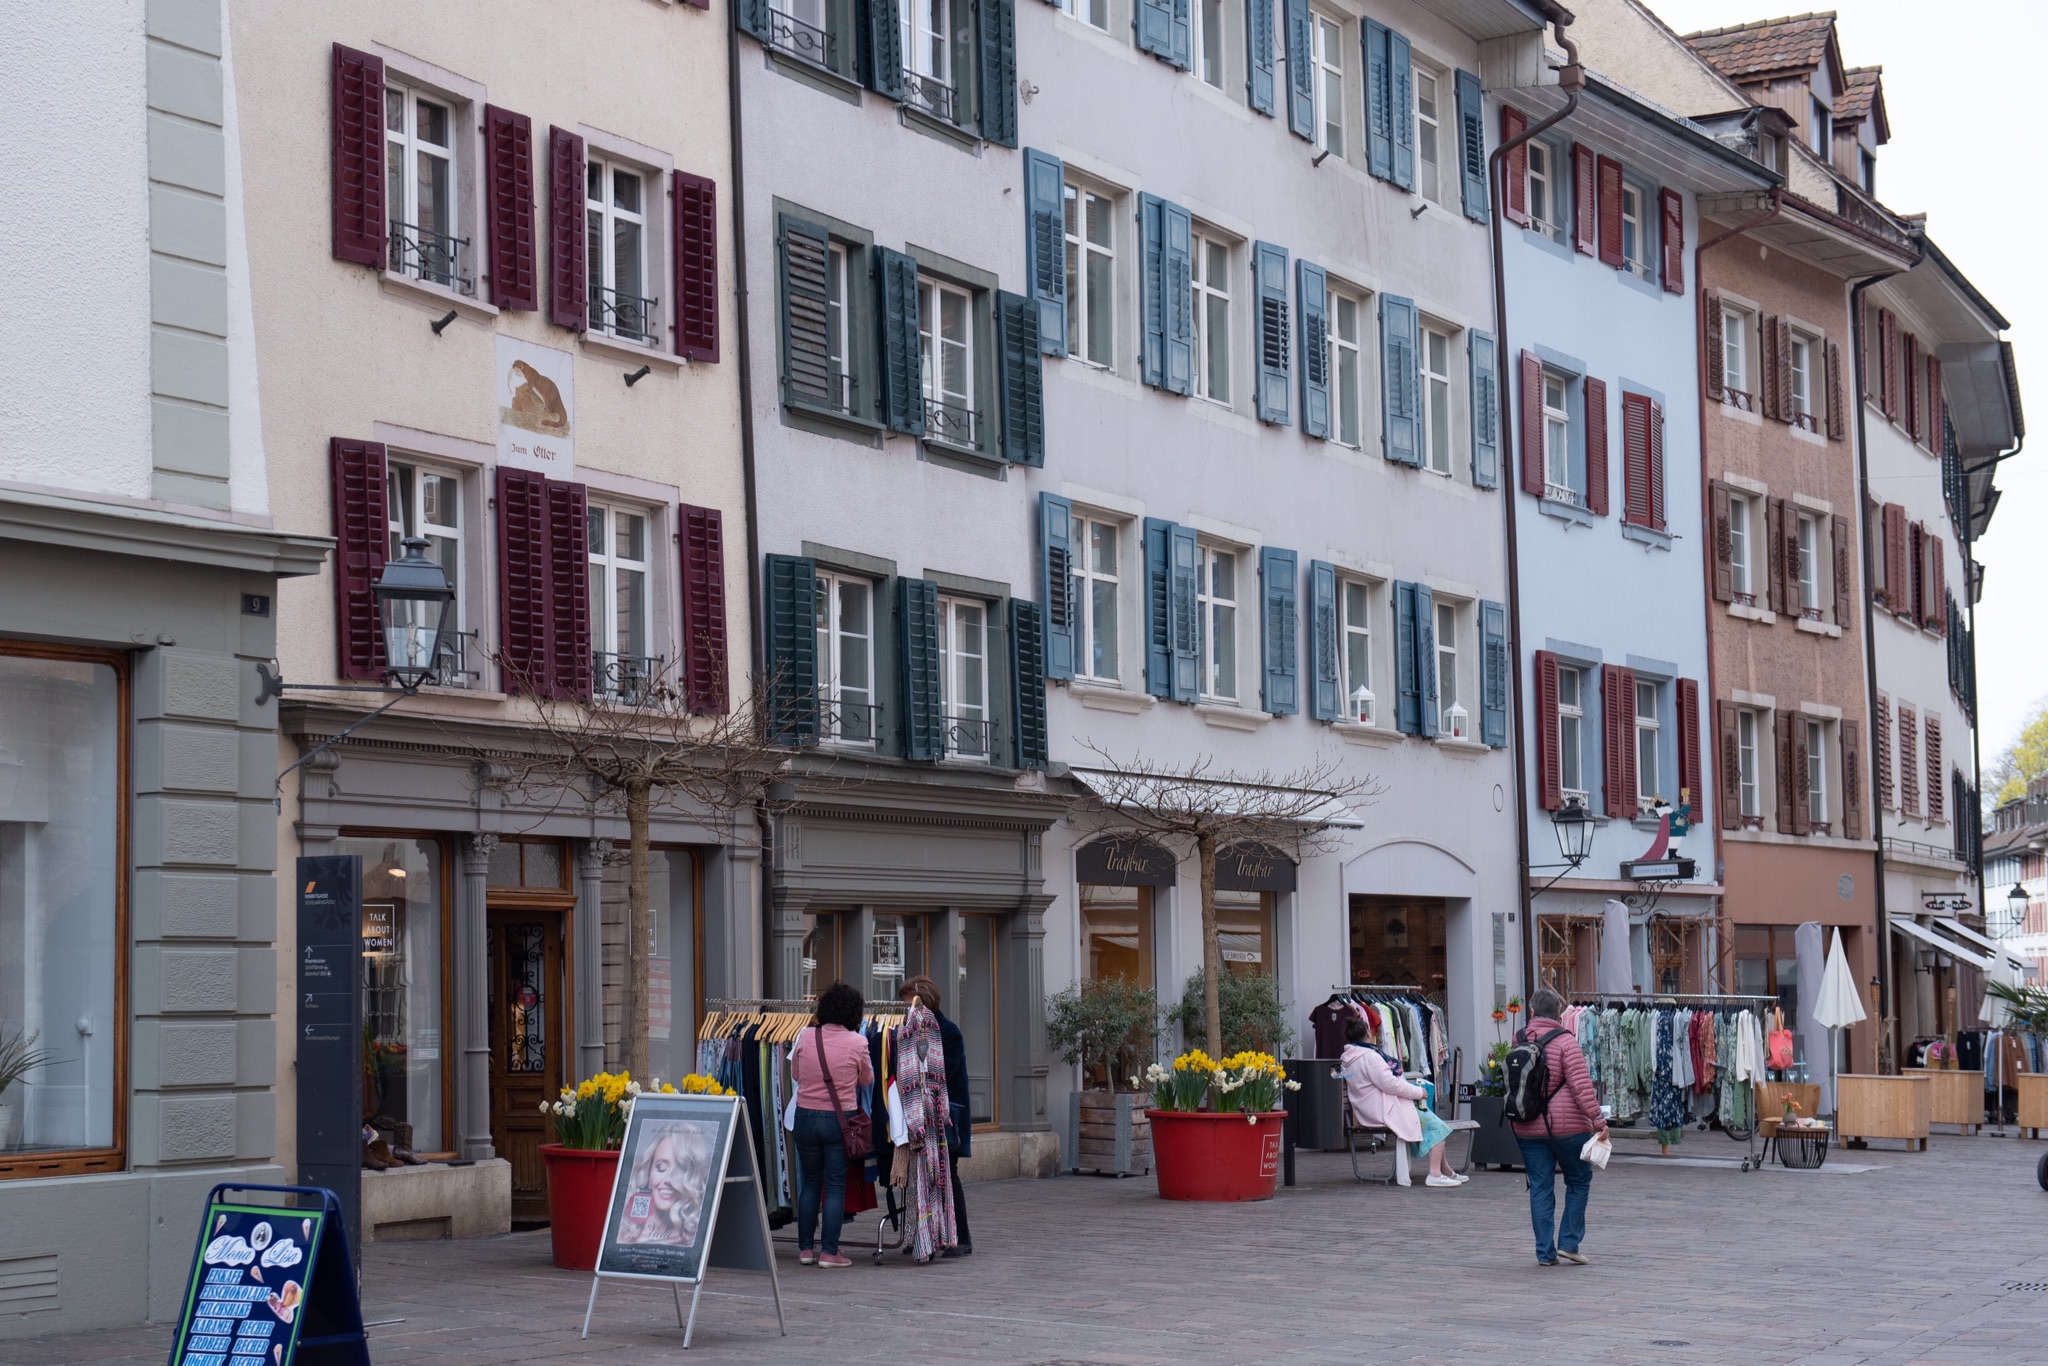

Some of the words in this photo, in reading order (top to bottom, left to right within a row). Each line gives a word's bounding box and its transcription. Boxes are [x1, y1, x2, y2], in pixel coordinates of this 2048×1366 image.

[533, 444, 557, 461] Otter
[252, 597, 260, 612] 9
[369, 913, 386, 922] TALK
[366, 925, 390, 934] ABOUT
[363, 938, 393, 947] WOMEN
[881, 946, 897, 954] ABOUT
[206, 1236, 253, 1261] Mona
[263, 1240, 299, 1265] Lisa
[196, 1302, 252, 1318] MILCHSHAKE
[191, 1318, 233, 1335] KARAMEL
[238, 1321, 275, 1336] BECHER
[188, 1336, 231, 1352] ERDBEER
[232, 1339, 269, 1354] BECHER
[183, 1353, 227, 1366] JOGHURT
[229, 1357, 265, 1366] BECHER
